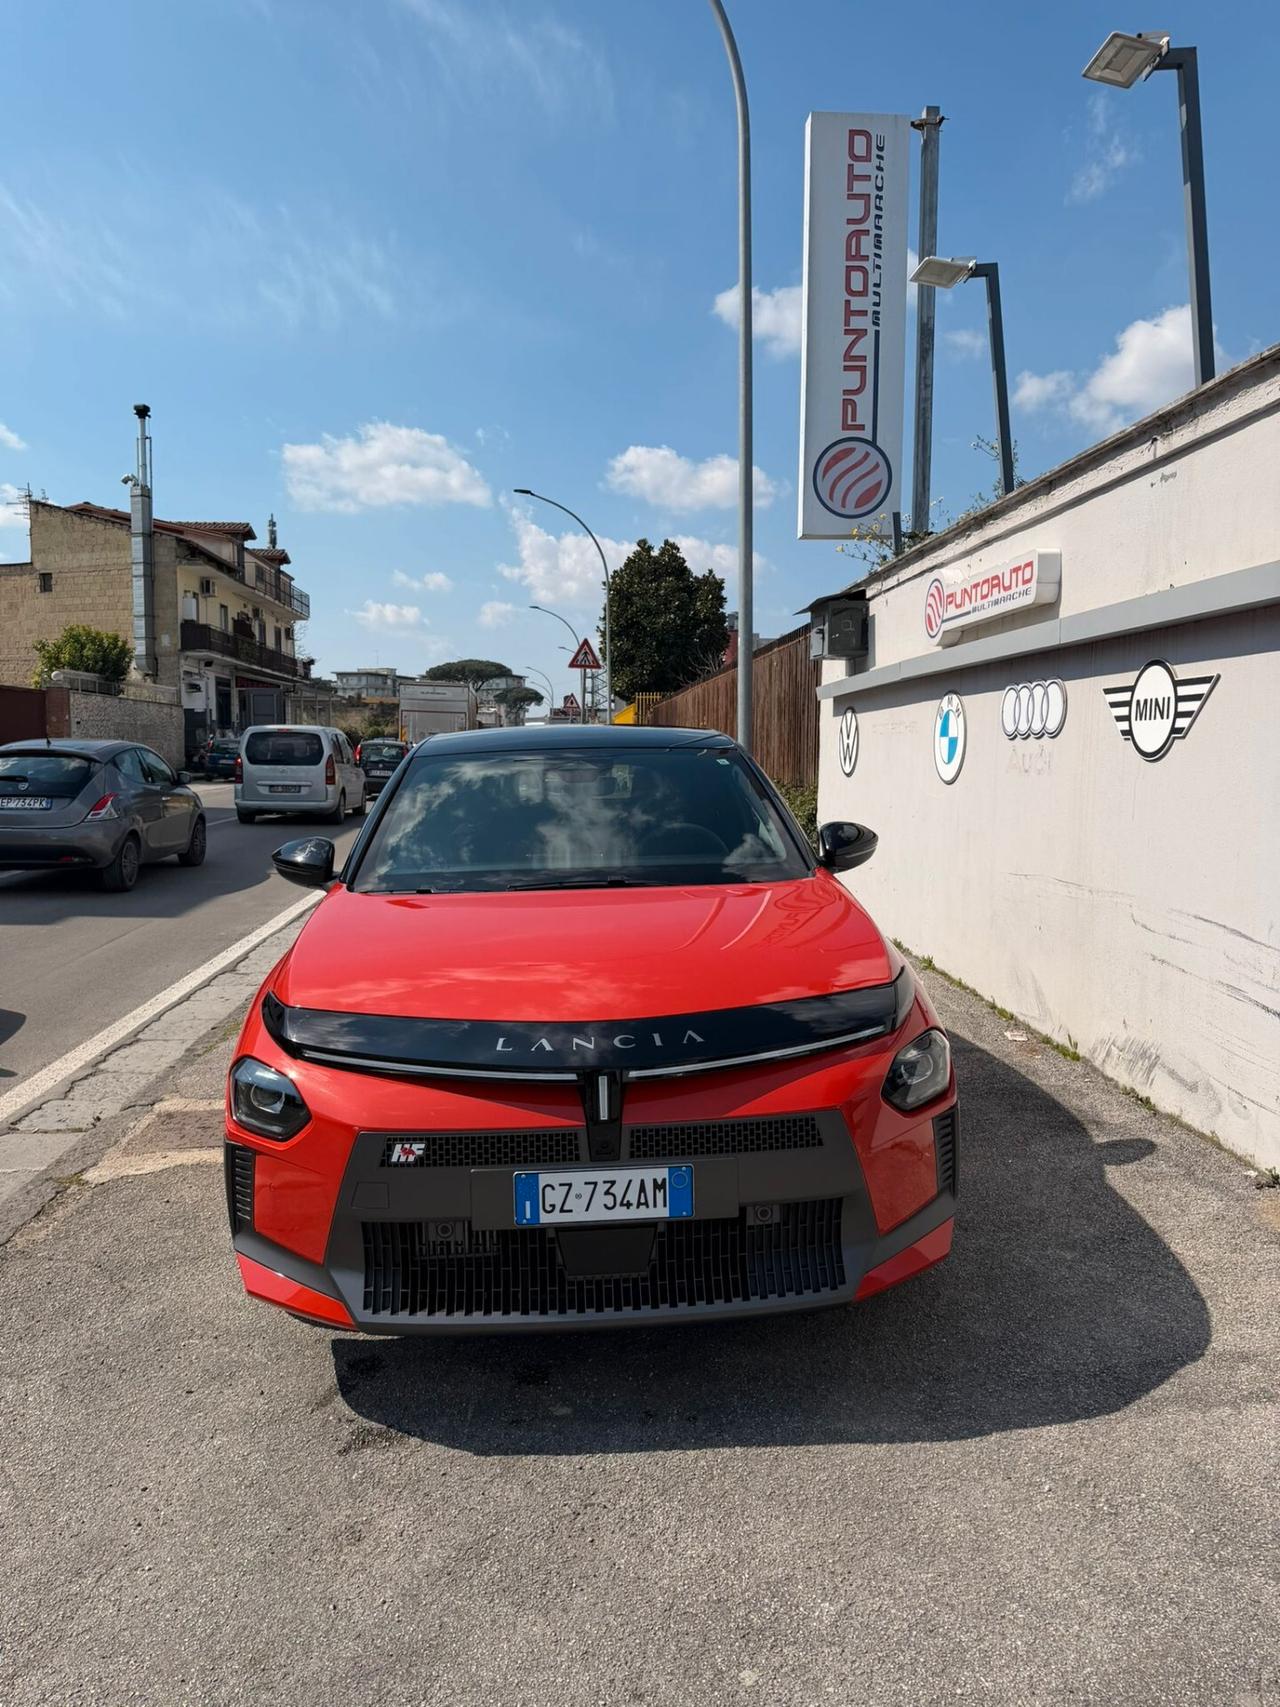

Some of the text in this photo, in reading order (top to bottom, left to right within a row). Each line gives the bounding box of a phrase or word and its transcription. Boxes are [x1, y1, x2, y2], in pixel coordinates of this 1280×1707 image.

[872, 134, 885, 327] MULTIMARCHE
[842, 129, 872, 431] PUNTOAUTO
[945, 560, 1034, 613] PUNTOAUTO
[971, 586, 1032, 614] MULTIMARCHE
[1134, 696, 1171, 722] MINI
[496, 1030, 705, 1052] LANCIA
